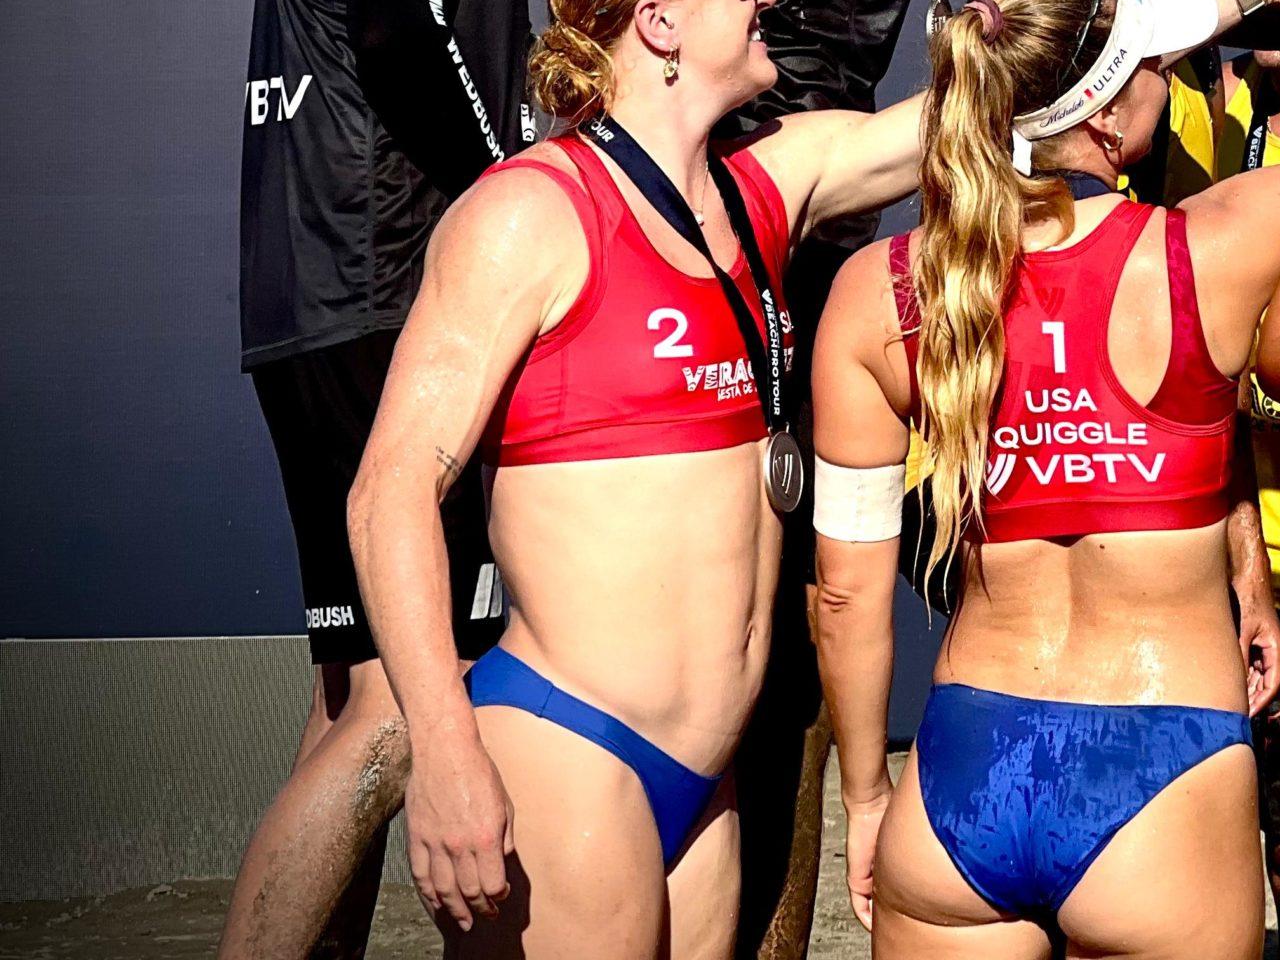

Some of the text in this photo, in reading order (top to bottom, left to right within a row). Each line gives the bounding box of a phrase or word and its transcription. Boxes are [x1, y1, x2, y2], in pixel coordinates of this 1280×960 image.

[1093, 48, 1128, 91] ULTRA
[591, 118, 615, 143] OUR
[647, 307, 693, 358] 2
[1041, 321, 1066, 373] 1
[764, 304, 781, 416] BEACH PRO TOUR
[1024, 388, 1098, 413] USA
[993, 421, 1149, 449] QUIGGLE
[1025, 453, 1166, 485] VBTV
